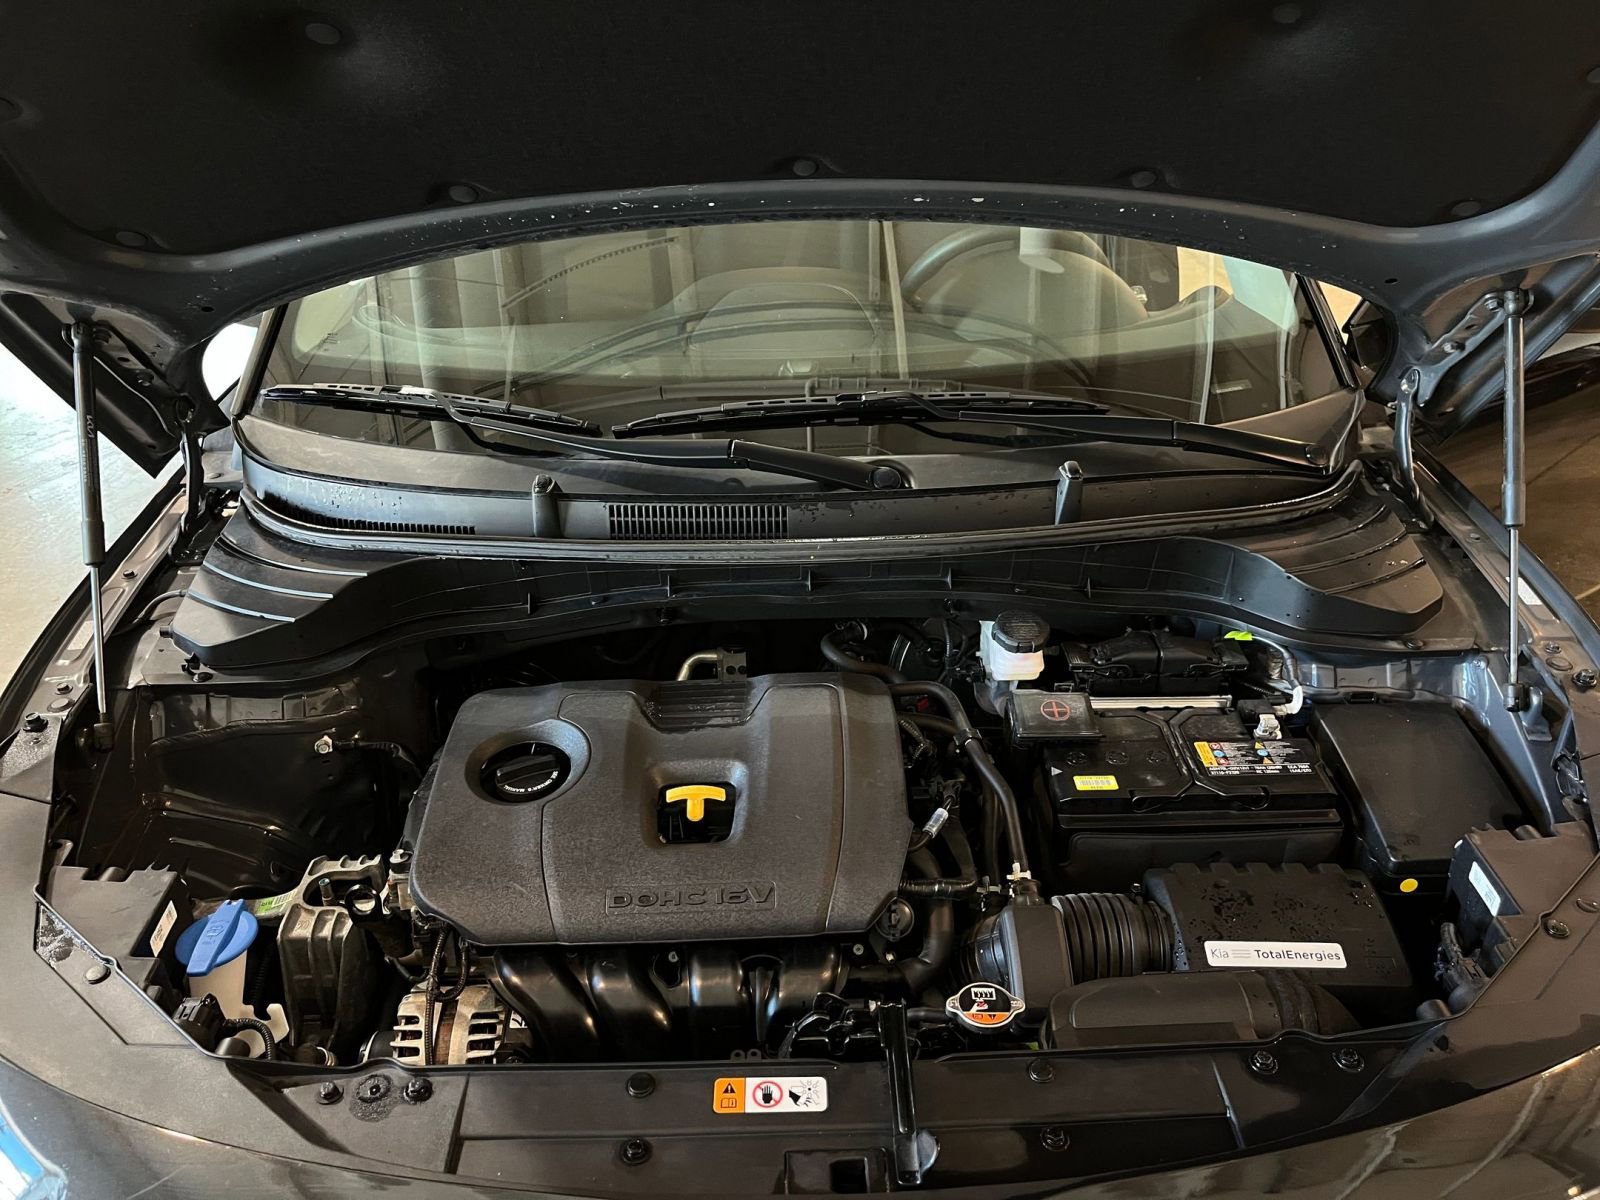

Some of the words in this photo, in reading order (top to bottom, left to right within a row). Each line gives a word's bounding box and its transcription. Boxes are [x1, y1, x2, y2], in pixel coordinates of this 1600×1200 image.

[607, 889, 707, 909] DOHC
[715, 885, 774, 905] 16V
[1210, 948, 1229, 959] Kia
[1253, 949, 1341, 961] TotalEnergies
